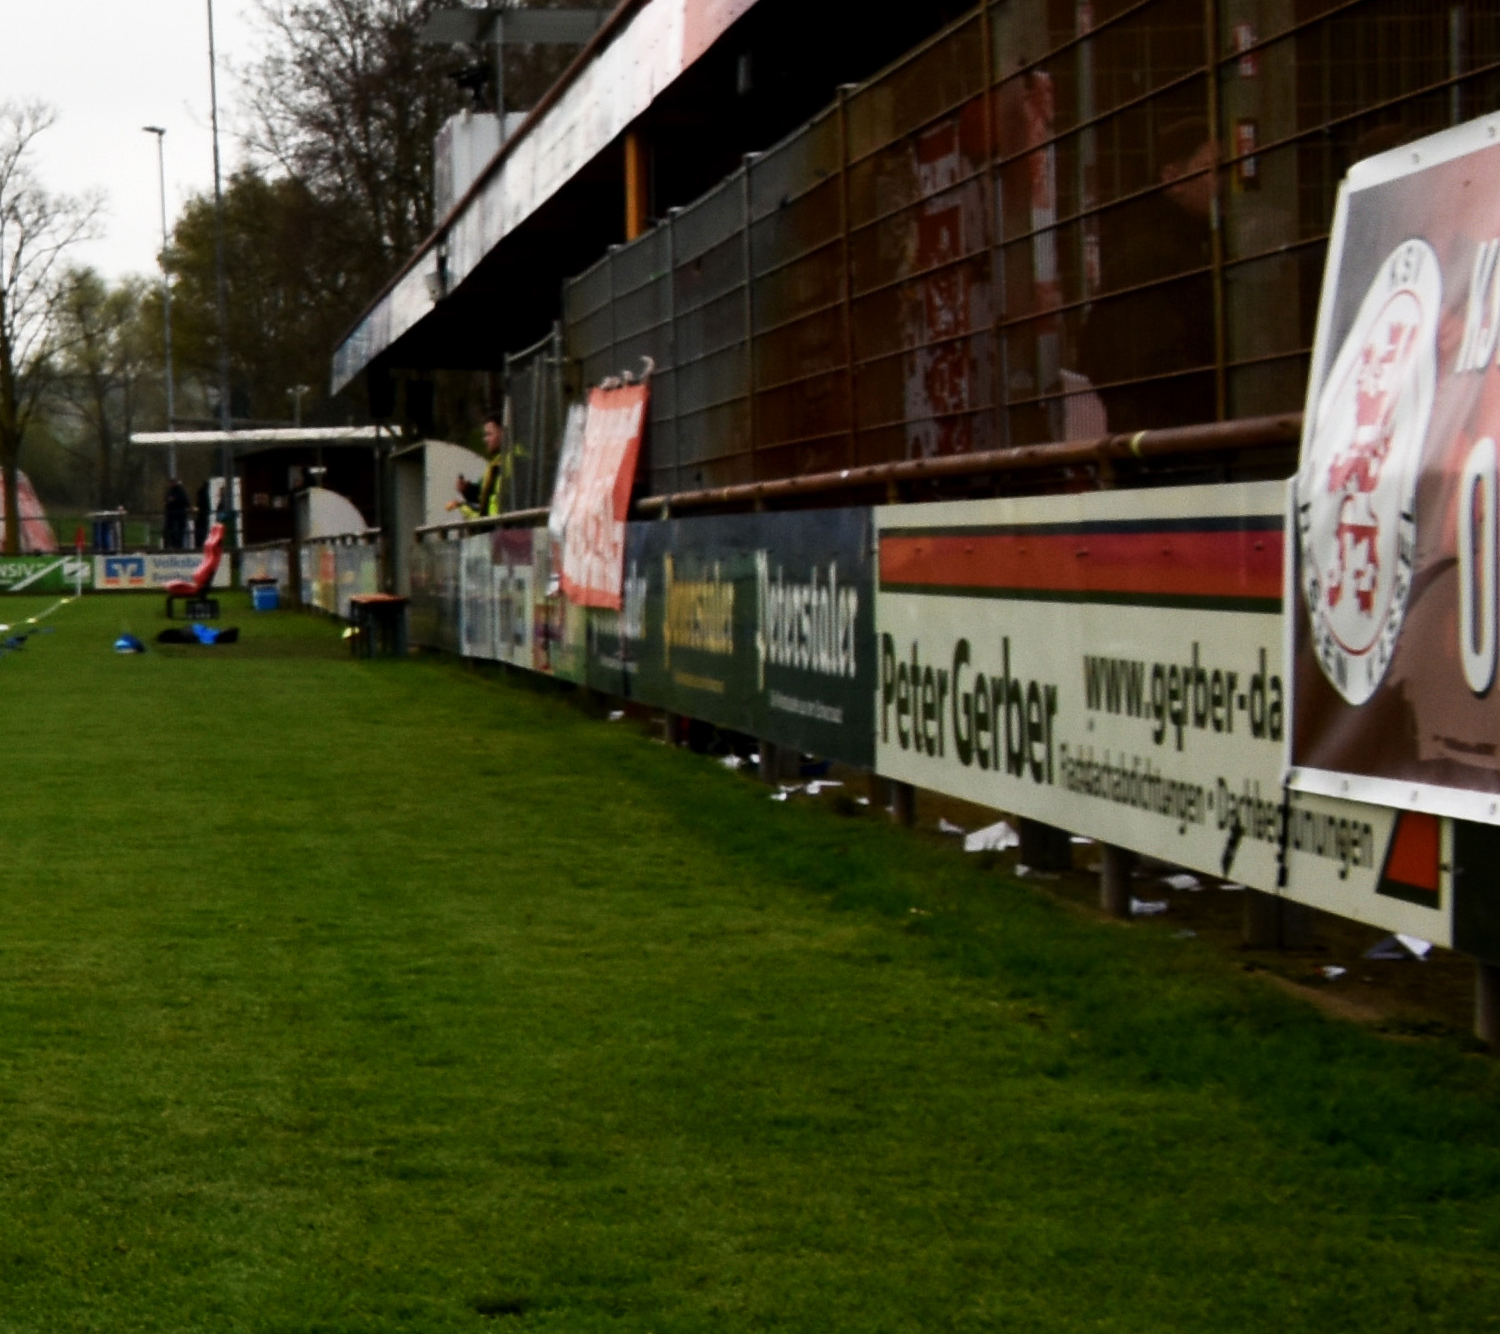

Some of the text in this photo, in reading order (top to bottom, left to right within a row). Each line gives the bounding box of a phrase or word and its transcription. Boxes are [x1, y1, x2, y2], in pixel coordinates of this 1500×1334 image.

[882, 629, 1058, 787] Peter Gerber
[1082, 640, 1284, 752] www.gerber-da
